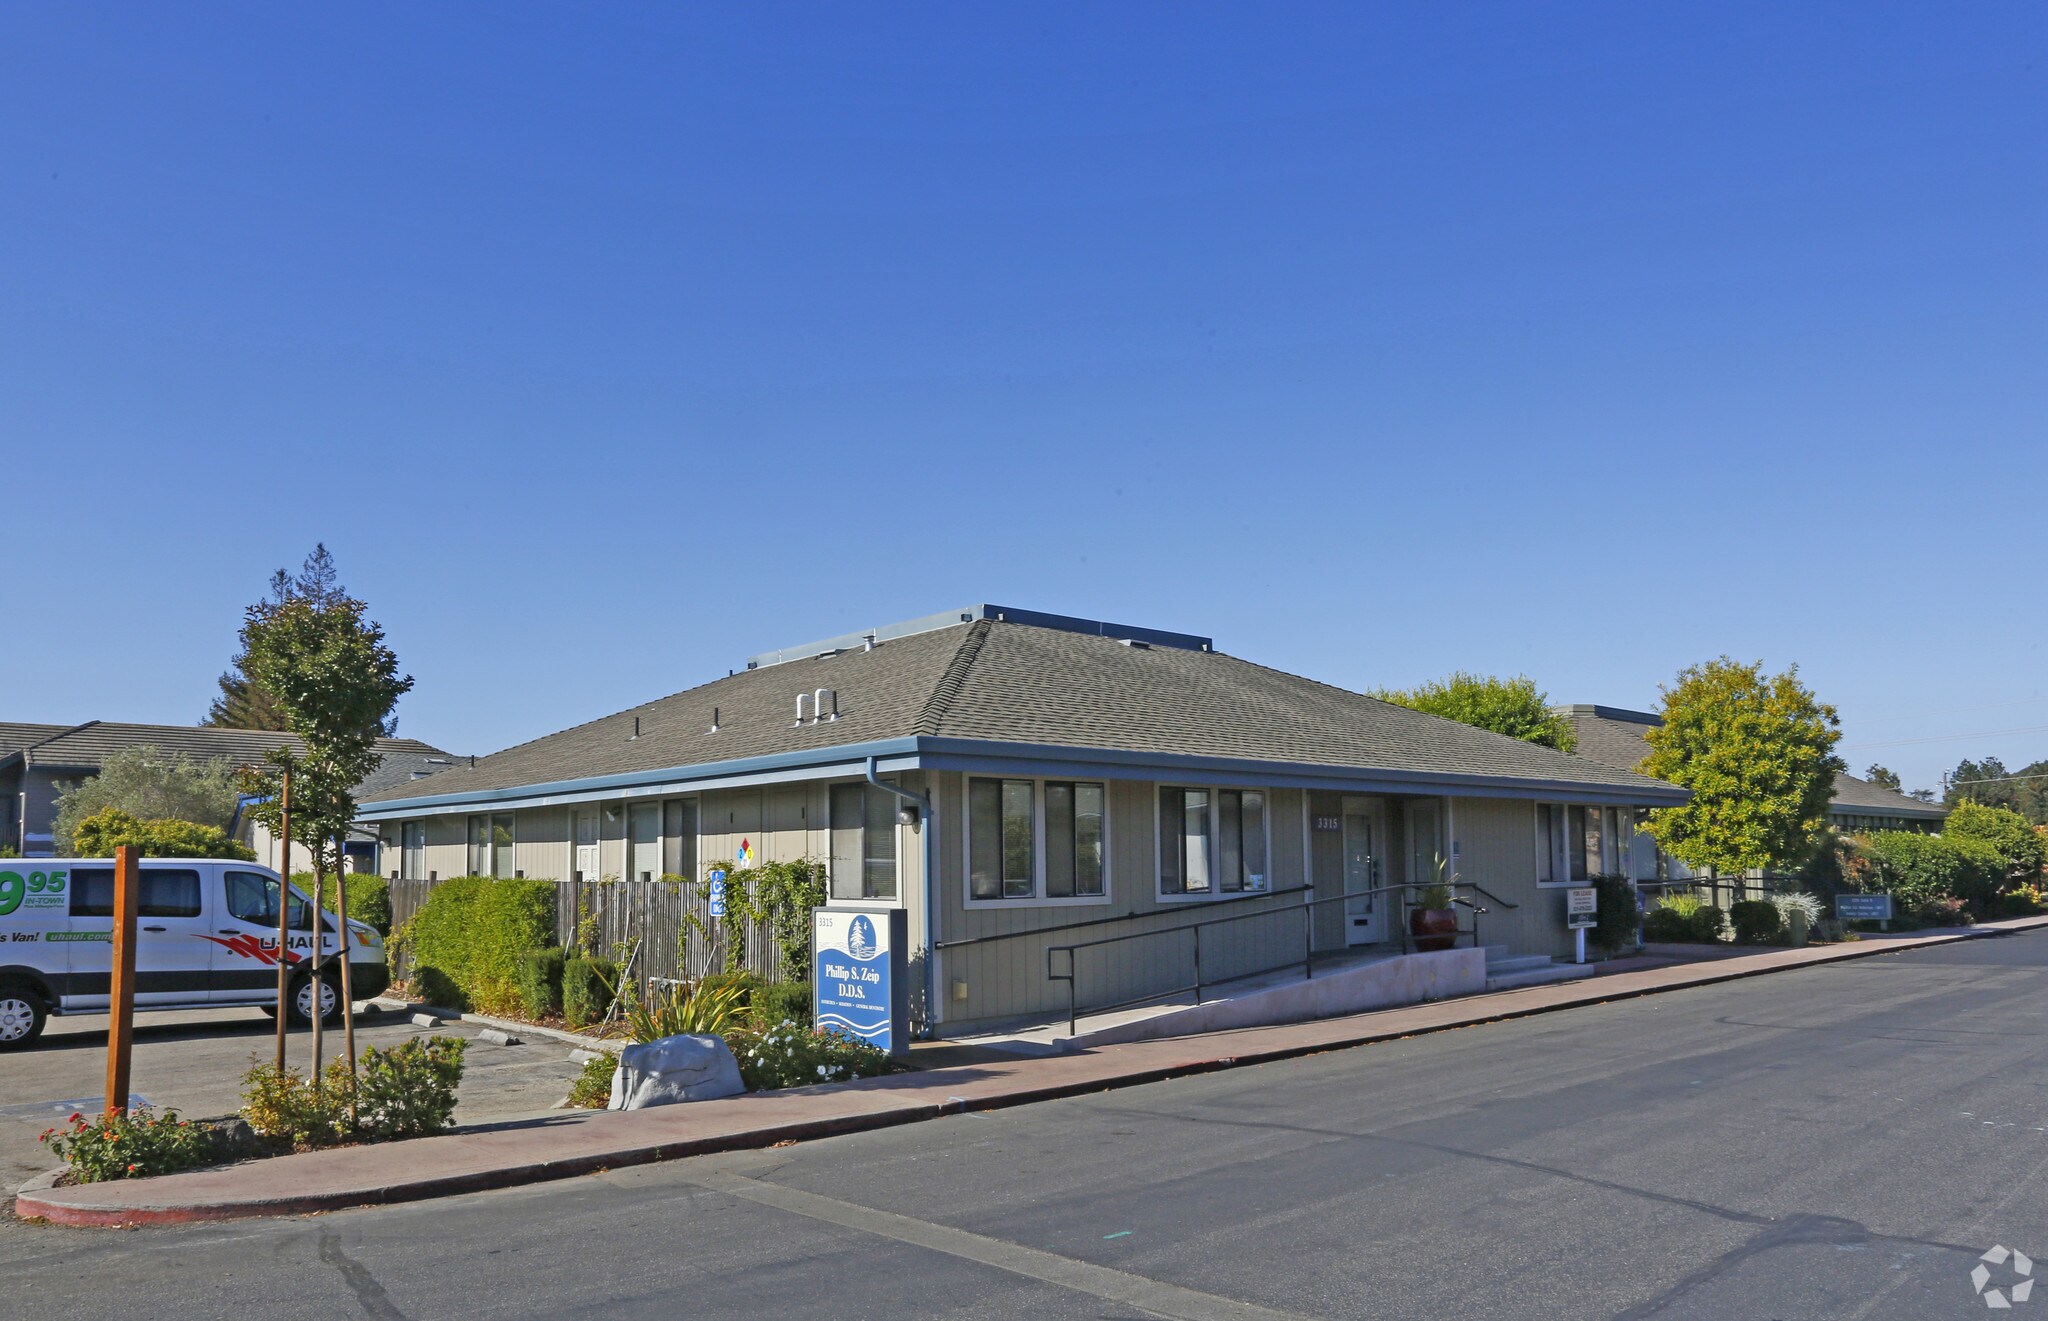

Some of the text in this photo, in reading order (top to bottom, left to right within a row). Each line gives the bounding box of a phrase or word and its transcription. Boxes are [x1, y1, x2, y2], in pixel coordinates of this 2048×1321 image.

[1318, 817, 1338, 829] 3315
[27, 871, 68, 893] 95
[25, 897, 65, 905] IN-TOWN
[819, 917, 833, 927] 3315
[12, 932, 40, 942] Van!
[50, 932, 112, 942] uhaul.com
[825, 964, 880, 984] Phillip S. Zeip
[838, 983, 866, 999] D.D.S.
